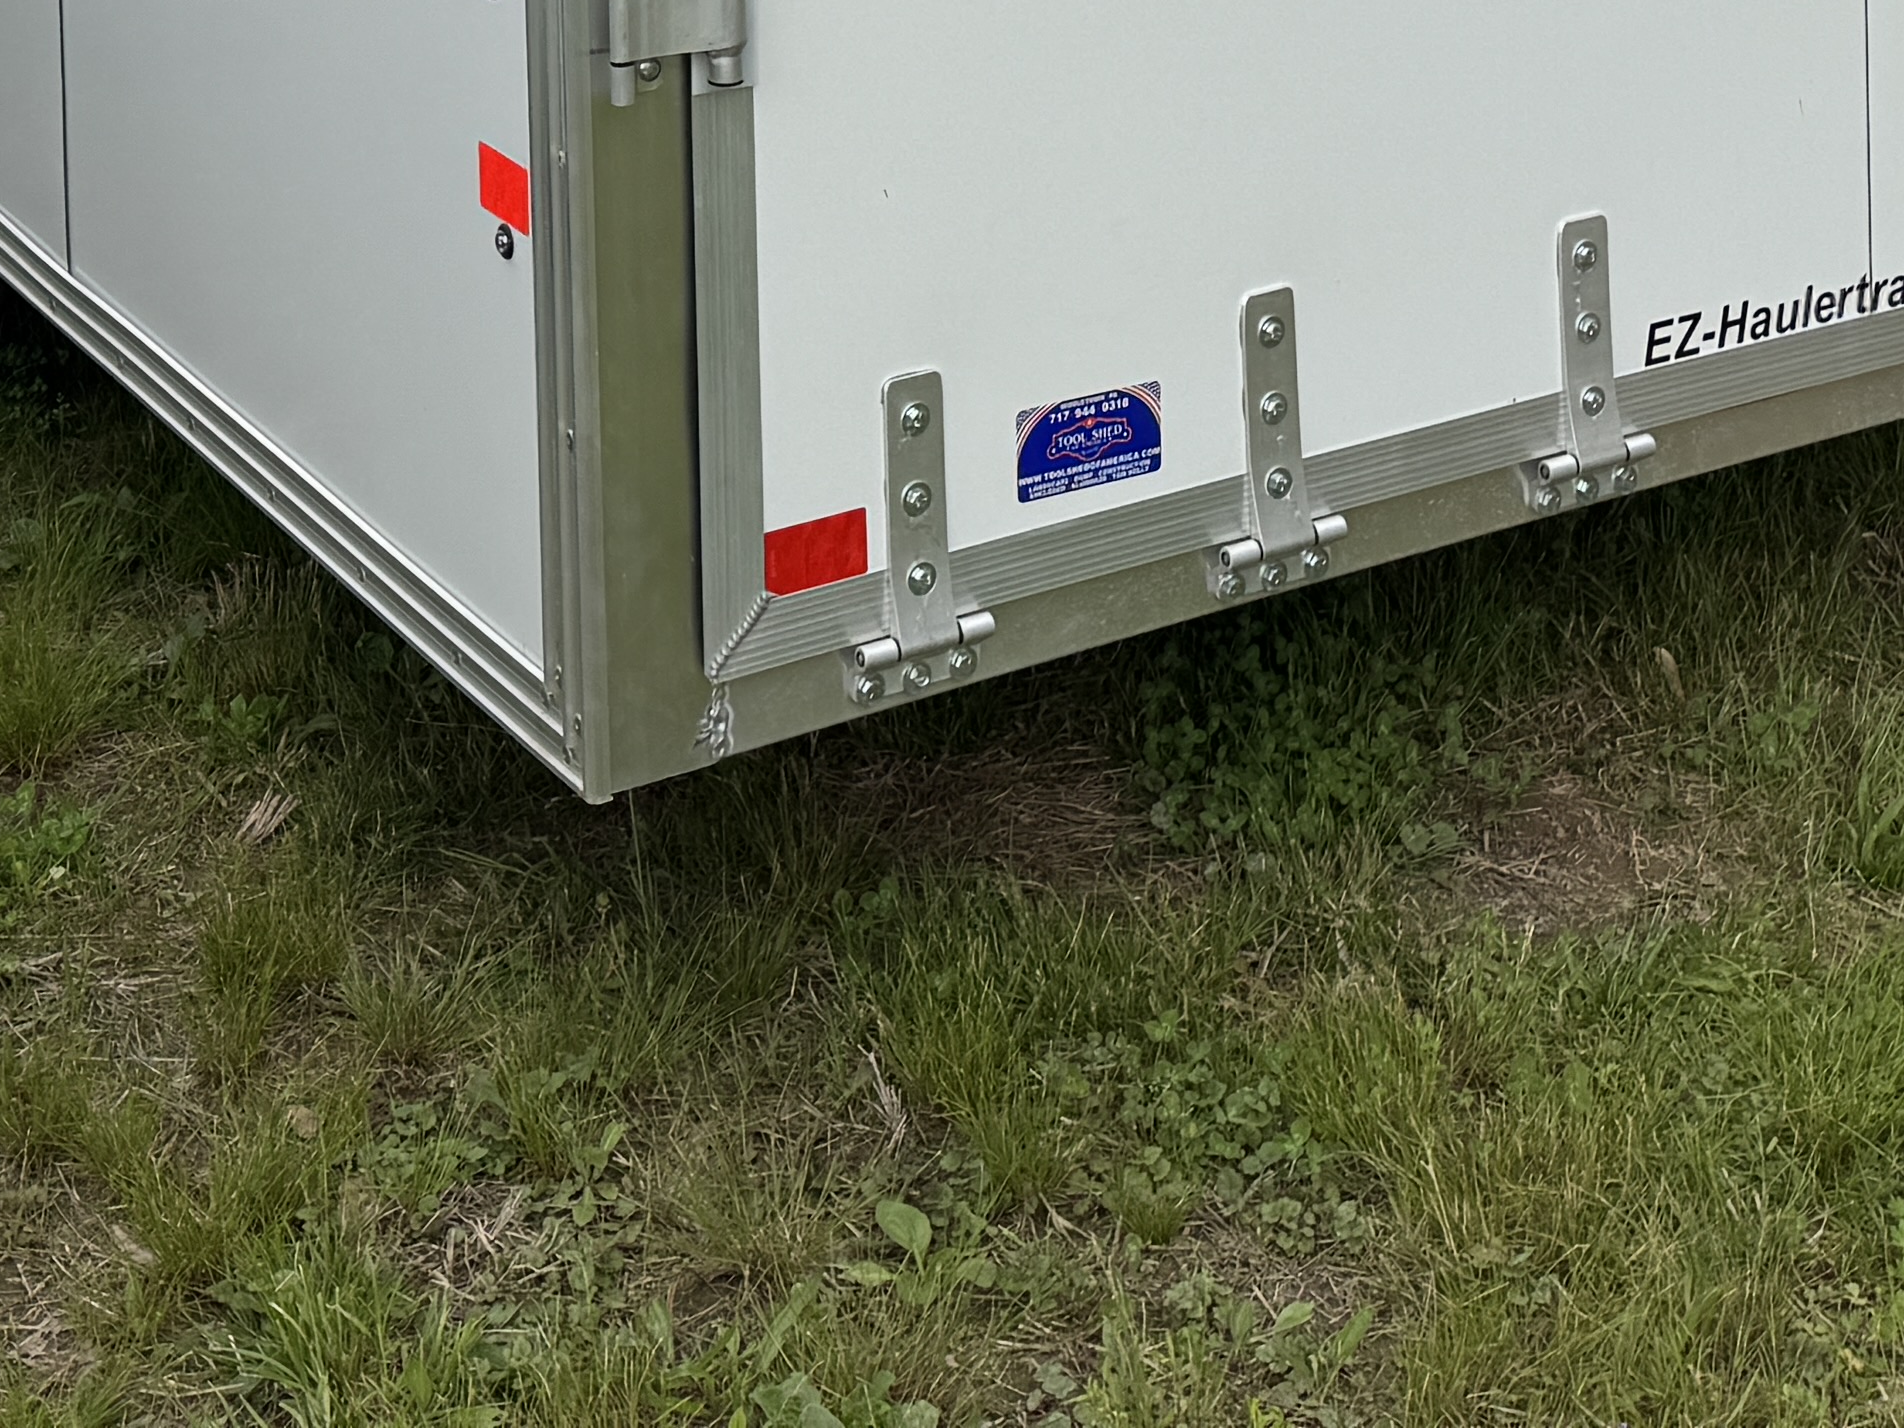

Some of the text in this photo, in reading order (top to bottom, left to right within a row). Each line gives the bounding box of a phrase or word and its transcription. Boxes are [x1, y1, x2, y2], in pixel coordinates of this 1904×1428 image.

[1048, 411, 1070, 424] 717
[1074, 405, 1096, 419] 944
[1057, 432, 1086, 448] TOOL
[1091, 424, 1123, 441] SHED
